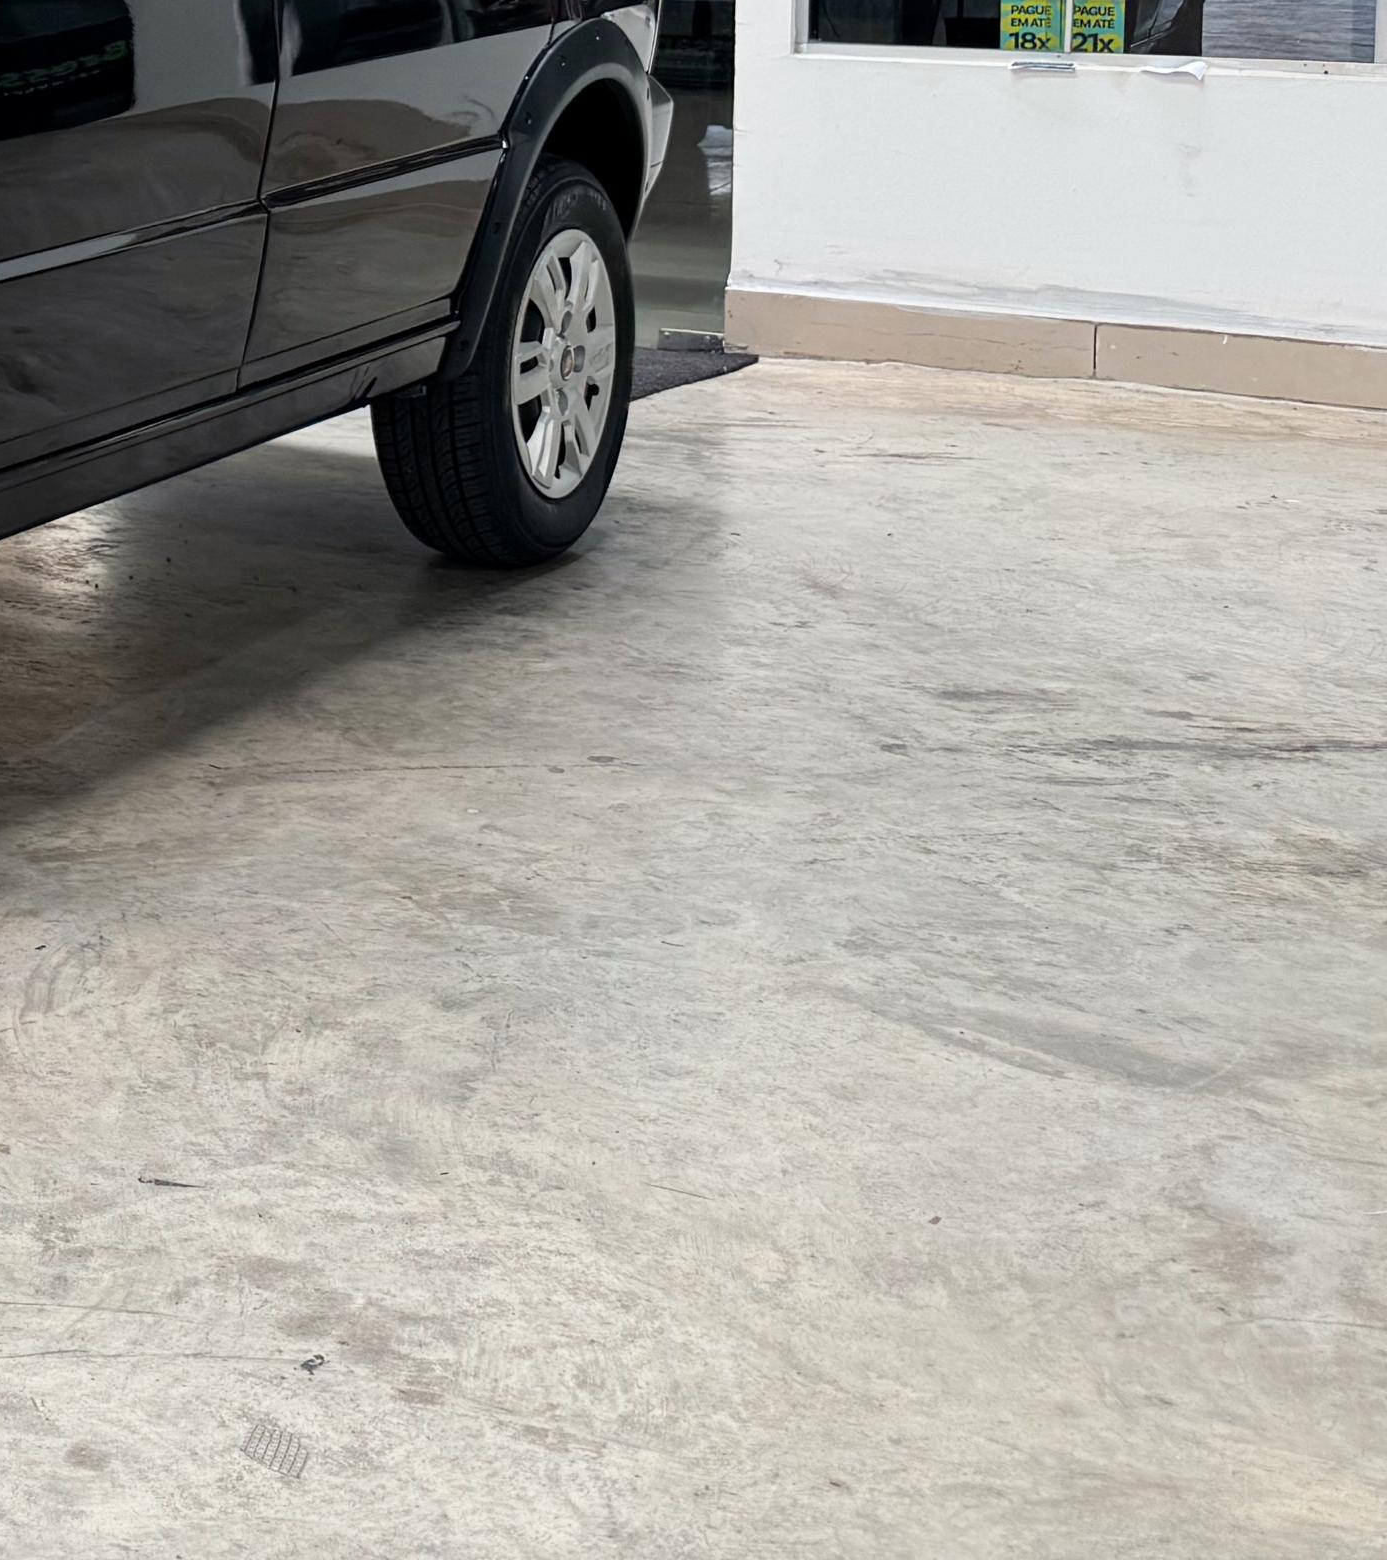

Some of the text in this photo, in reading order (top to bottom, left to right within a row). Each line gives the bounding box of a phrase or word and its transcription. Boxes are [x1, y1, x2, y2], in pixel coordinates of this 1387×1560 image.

[1010, 4, 1052, 16] PAGUE
[1073, 5, 1115, 17] PAGUE
[1010, 16, 1052, 28] EM ATÉ
[1072, 19, 1091, 29] EM
[1008, 31, 1052, 51] 18x
[1072, 32, 1115, 53] 21x
